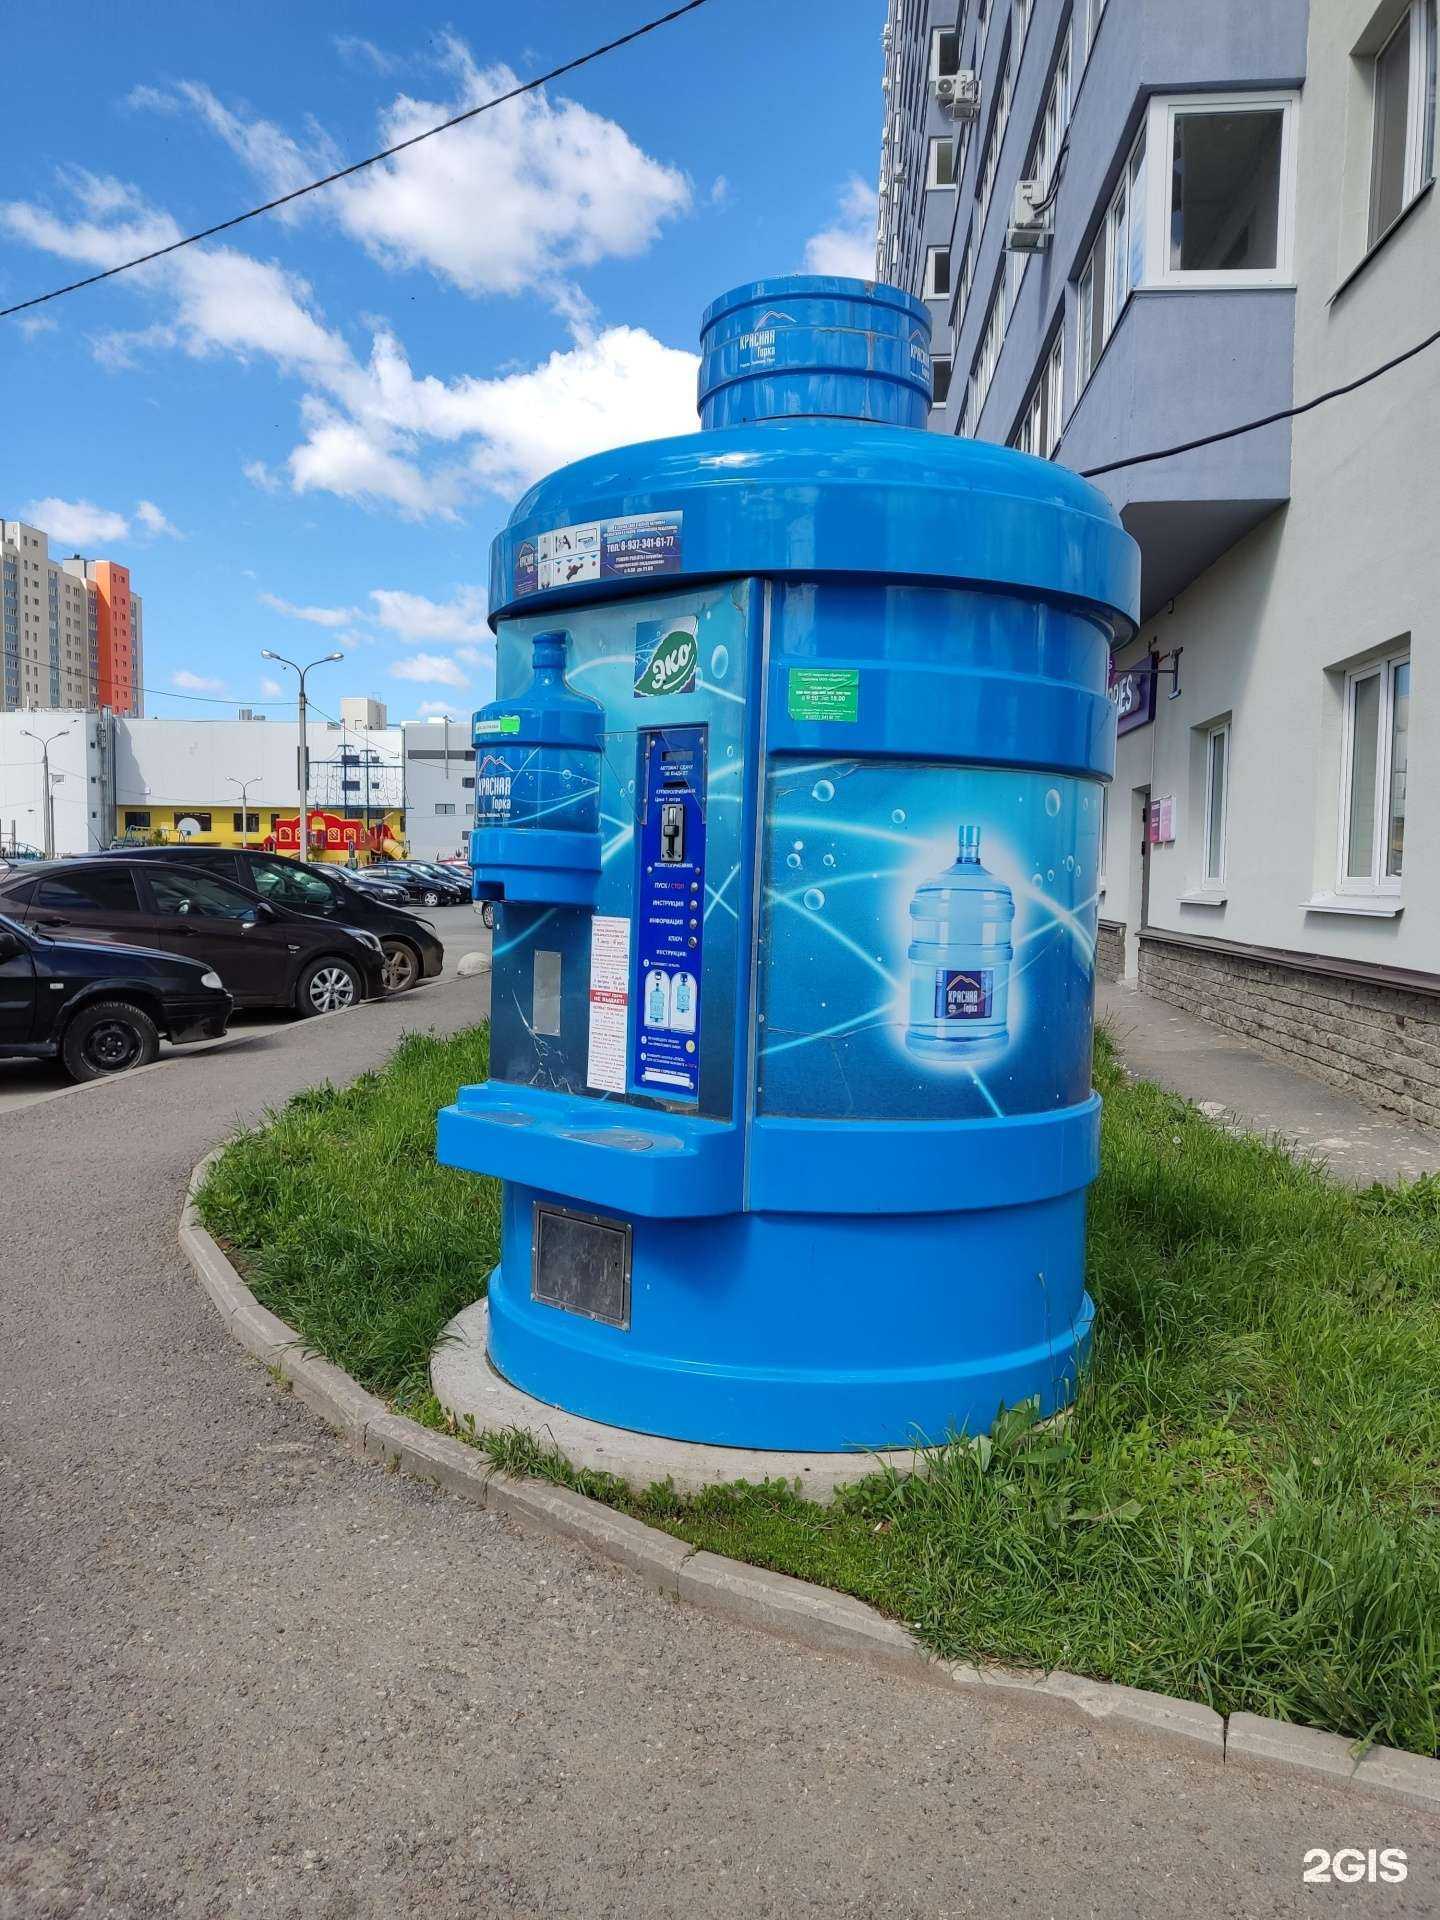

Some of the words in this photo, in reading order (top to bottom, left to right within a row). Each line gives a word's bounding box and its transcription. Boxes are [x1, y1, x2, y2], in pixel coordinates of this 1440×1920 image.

[740, 330, 775, 350] КРАСНАЯ
[757, 347, 775, 359] Горка
[651, 642, 692, 689] ЭКО
[492, 796, 511, 812] Горка
[948, 990, 978, 1003] КРАСНАЯ
[964, 1003, 978, 1014] Горка
